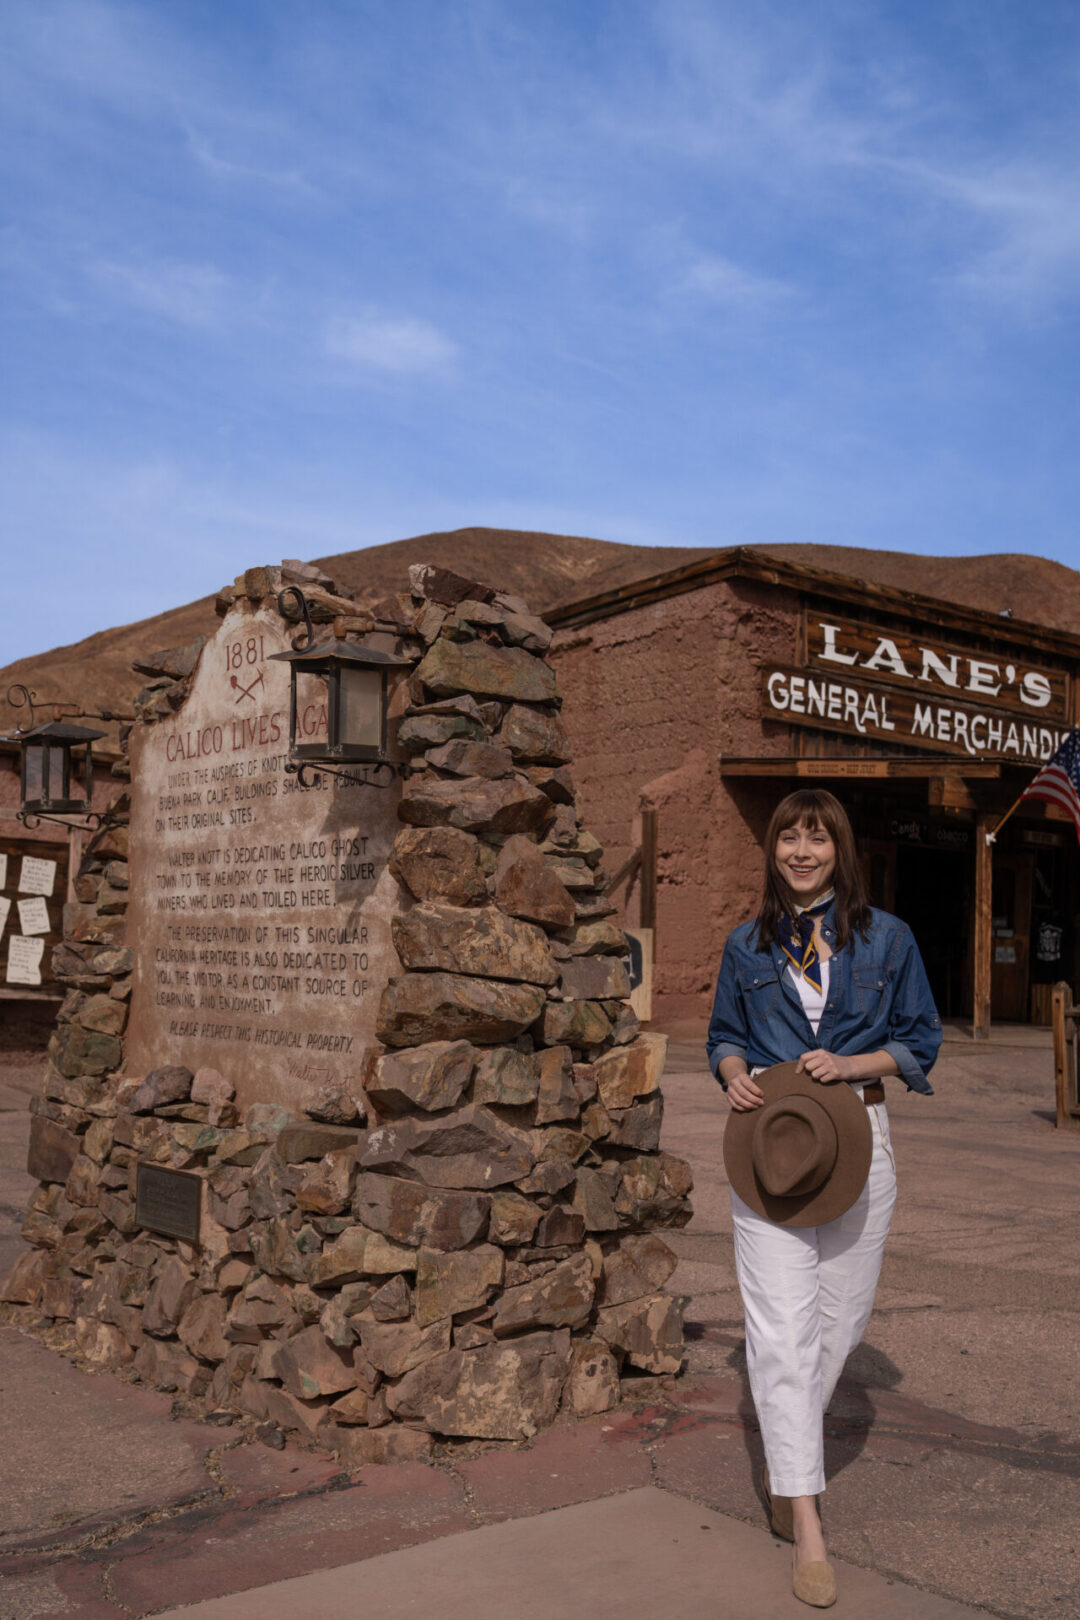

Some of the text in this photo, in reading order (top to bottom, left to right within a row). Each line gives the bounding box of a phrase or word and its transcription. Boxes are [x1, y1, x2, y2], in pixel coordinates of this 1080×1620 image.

[226, 636, 264, 671] 1881
[817, 623, 1052, 708] LANE'S
[768, 672, 895, 733] GENERAL
[166, 725, 222, 762] CALICO
[232, 712, 281, 751] LIVES
[168, 772, 190, 788] UNDER
[194, 768, 209, 784] THE
[211, 762, 244, 782] AUSPICES
[248, 760, 258, 776] OF
[159, 795, 181, 810] BUENA
[183, 792, 202, 806] PARK
[207, 784, 229, 803] CALIF.
[235, 778, 278, 801] BUILDINGS
[283, 775, 311, 795] SHALL
[155, 807, 257, 832] ON THEIR ORIGINAL SITES.
[169, 837, 369, 866] WALTER KNOTT IS DEDICATING CALICO GHOST
[156, 863, 376, 888] TOWN TO THE MEMORY OF THE HEROIC SILVER
[157, 889, 337, 910] MINERS WHO LIVED AND TOILED HERE.
[168, 926, 369, 945] THE PRESERVATION OF THIS SINGULAR
[156, 949, 369, 971] CALIFORNIA HERITAGE IS ALSO DEDICATED TO
[175, 972, 190, 985] THE
[194, 974, 222, 987] VISITOR
[227, 975, 238, 989] AS
[242, 976, 249, 989] A
[252, 976, 300, 993] CONSTANT
[305, 978, 346, 996] SOURCE
[353, 980, 368, 997] OF
[156, 992, 275, 1014] LEARNING AND ENJOYMENT.
[169, 1022, 354, 1054] PLEASE RESPECT THIS HISTORICAL PROPERTY.
